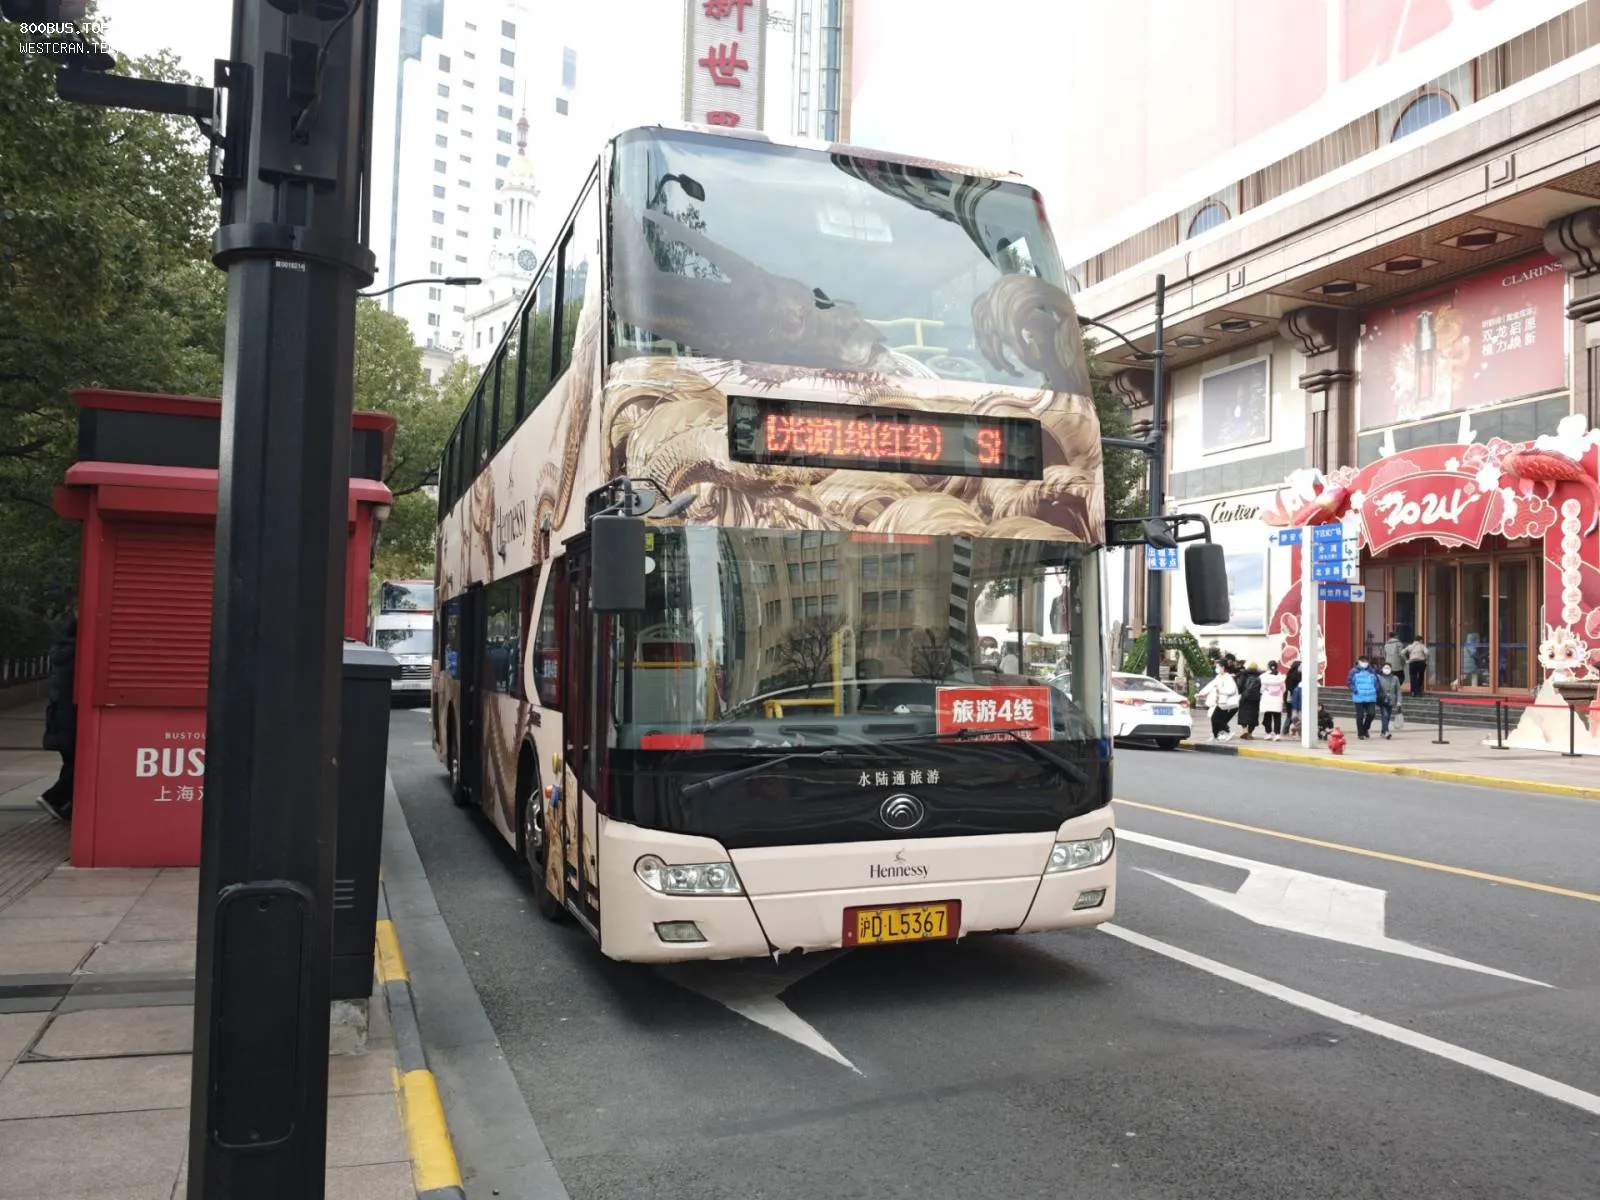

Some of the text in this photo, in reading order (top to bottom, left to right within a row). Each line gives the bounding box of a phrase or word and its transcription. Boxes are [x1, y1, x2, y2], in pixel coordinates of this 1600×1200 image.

[1502, 261, 1563, 287] CLARINS
[1211, 501, 1260, 524] Cartier
[953, 699, 1034, 723] 旅游4线
[136, 748, 205, 777] BUS
[858, 769, 940, 788] 水陆通旅游
[870, 864, 929, 879] Hennessy
